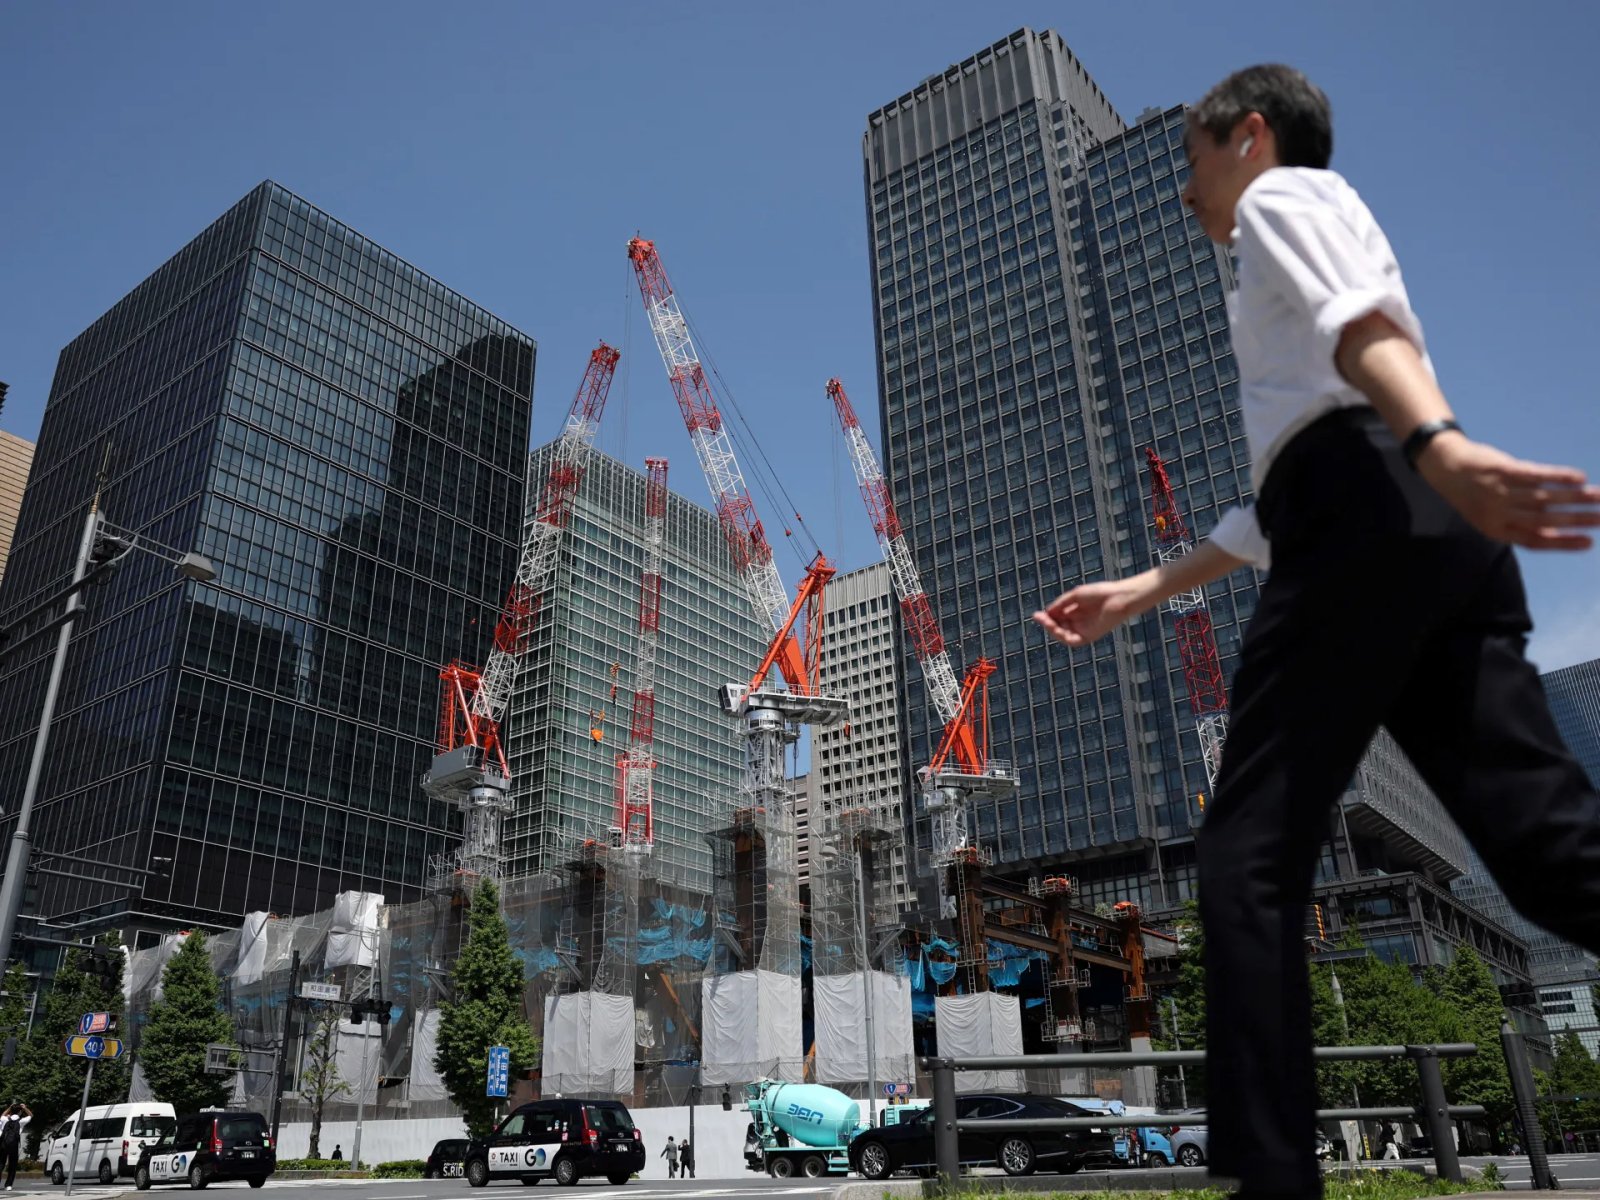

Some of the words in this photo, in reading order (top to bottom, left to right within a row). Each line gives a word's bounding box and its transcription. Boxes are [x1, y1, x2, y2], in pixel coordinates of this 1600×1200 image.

[86, 1016, 90, 1028] 1
[152, 1161, 167, 1174] TAXI
[171, 1154, 187, 1174] GO
[500, 1152, 518, 1163] TAXI
[524, 1147, 546, 1167] GO
[443, 1166, 464, 1177] S.RID
